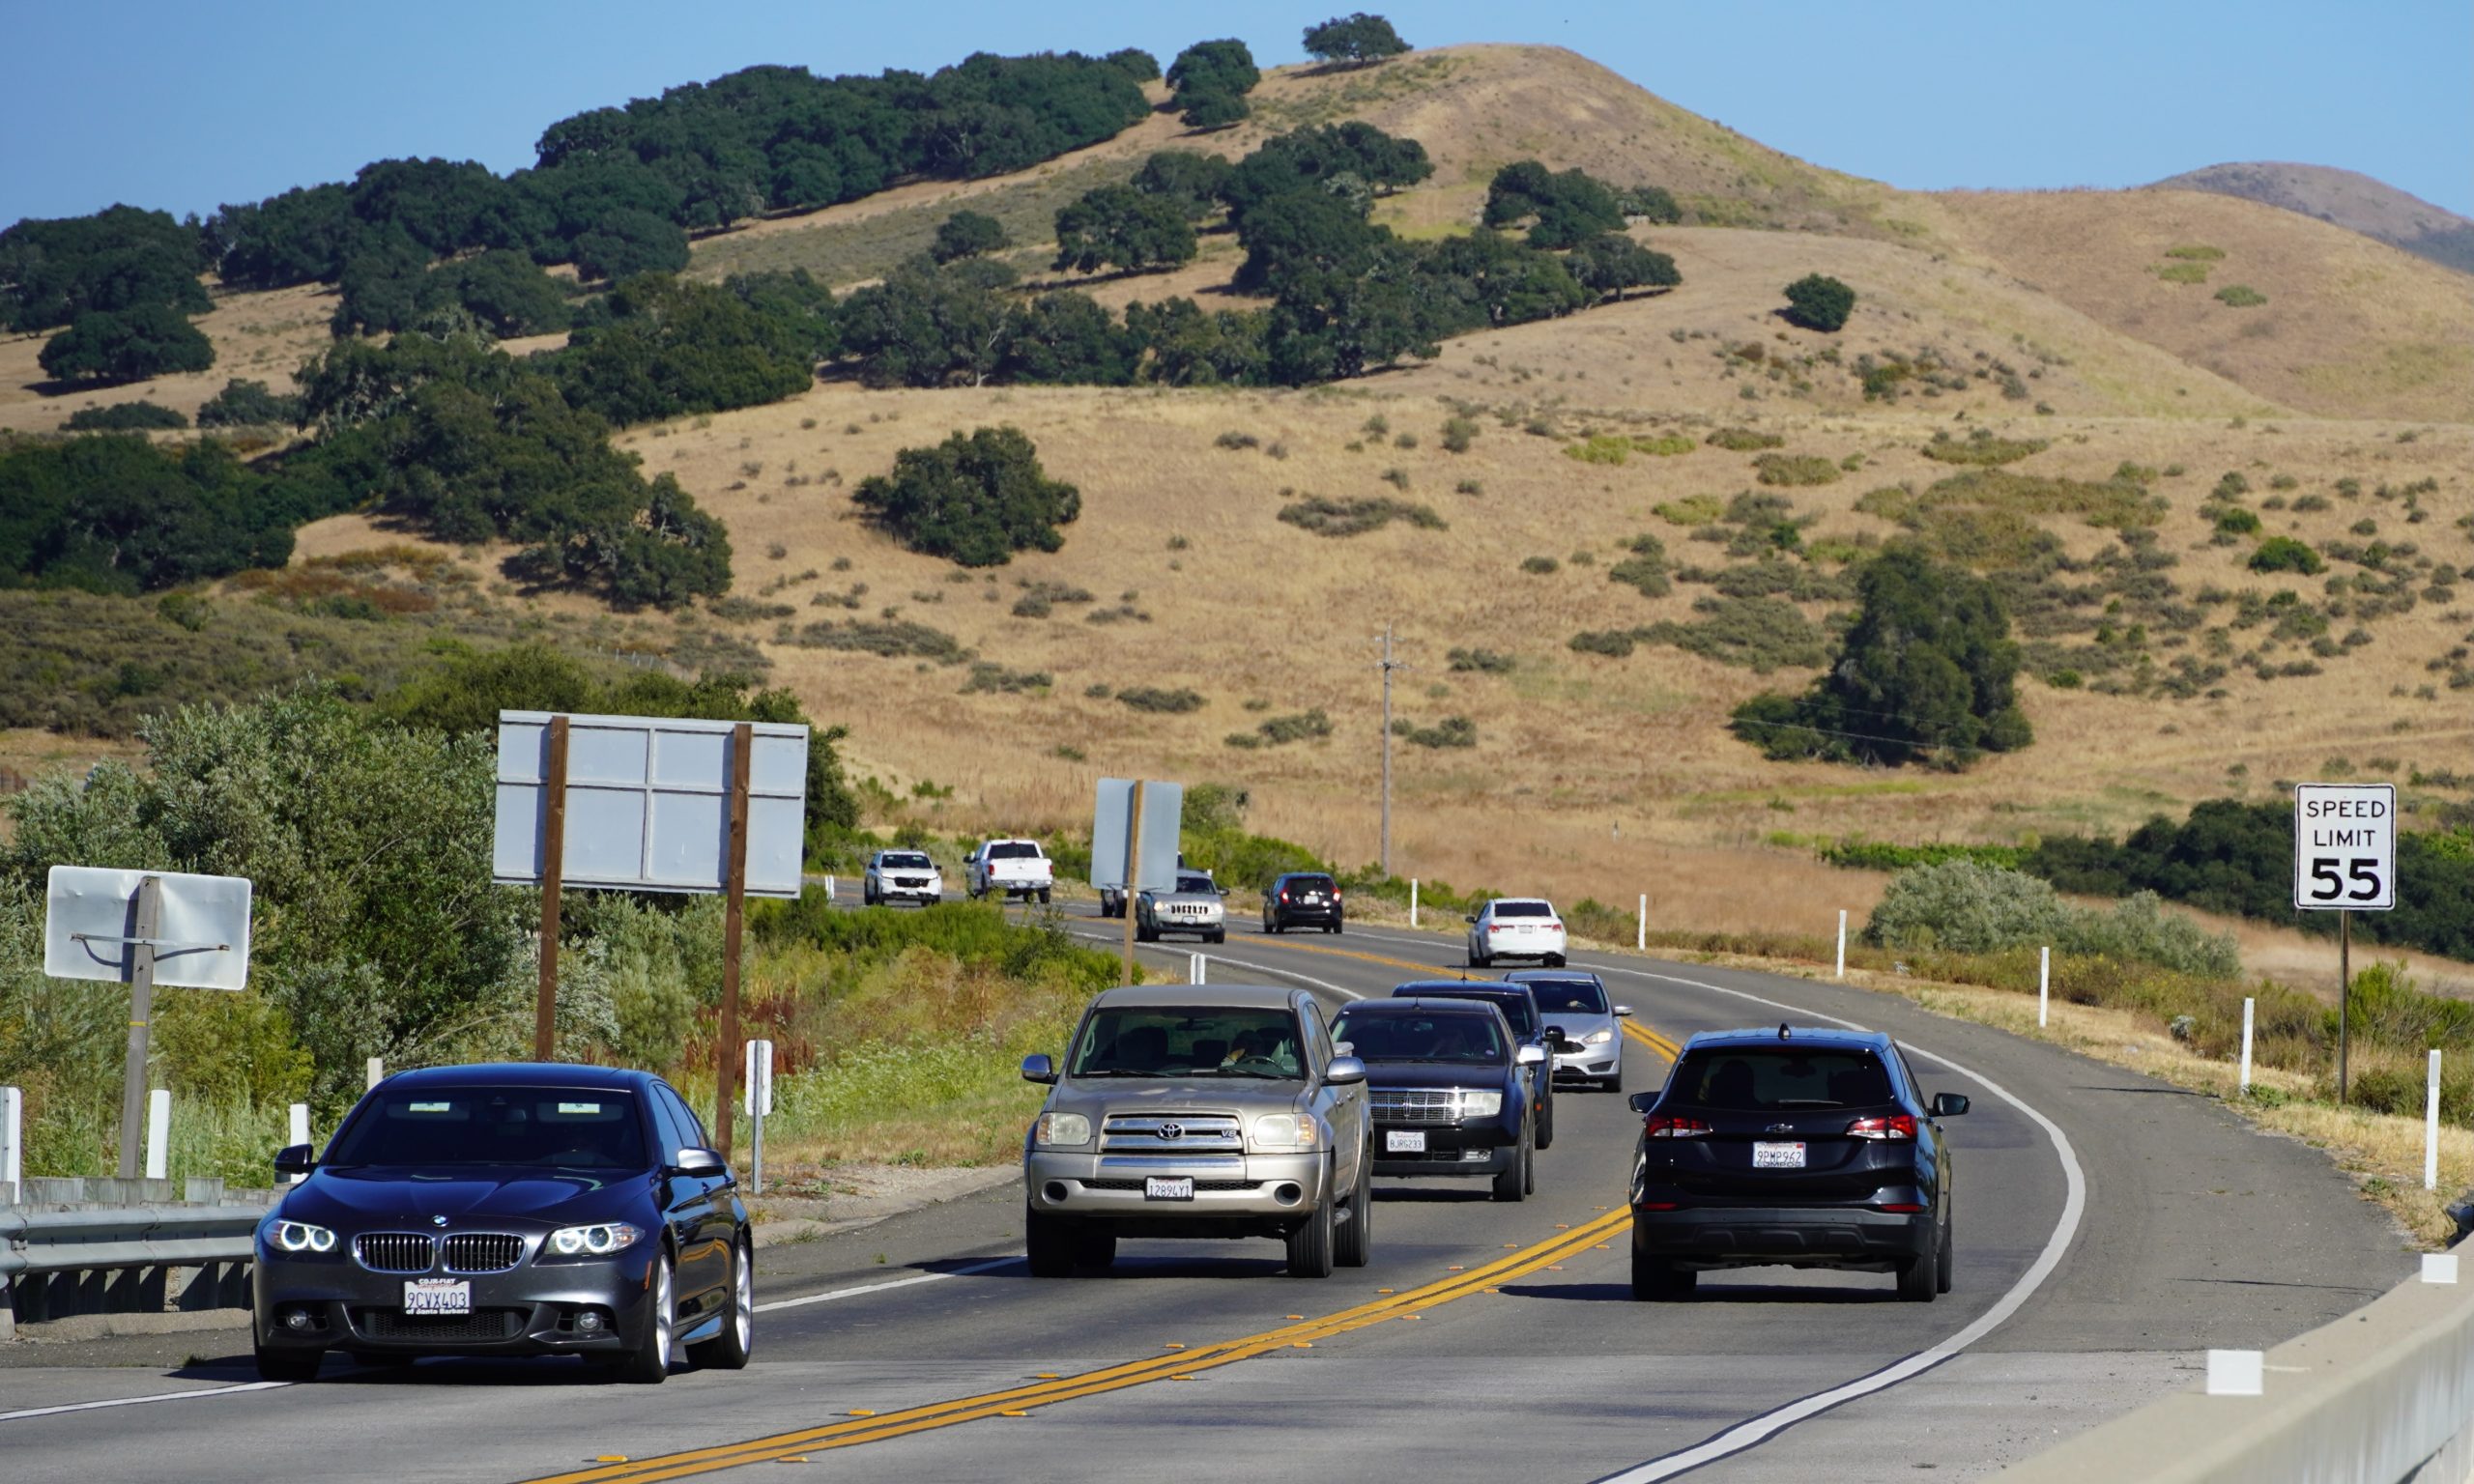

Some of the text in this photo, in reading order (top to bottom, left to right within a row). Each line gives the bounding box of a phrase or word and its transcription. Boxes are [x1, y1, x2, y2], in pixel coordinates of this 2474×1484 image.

[2307, 801, 2385, 817] SPEED
[2315, 830, 2375, 846] LIMIT
[2311, 858, 2381, 900] 55
[1221, 1128, 1238, 1138] V8
[1758, 1151, 1801, 1162] 9PMP962
[408, 1292, 466, 1309] 9CVX403
